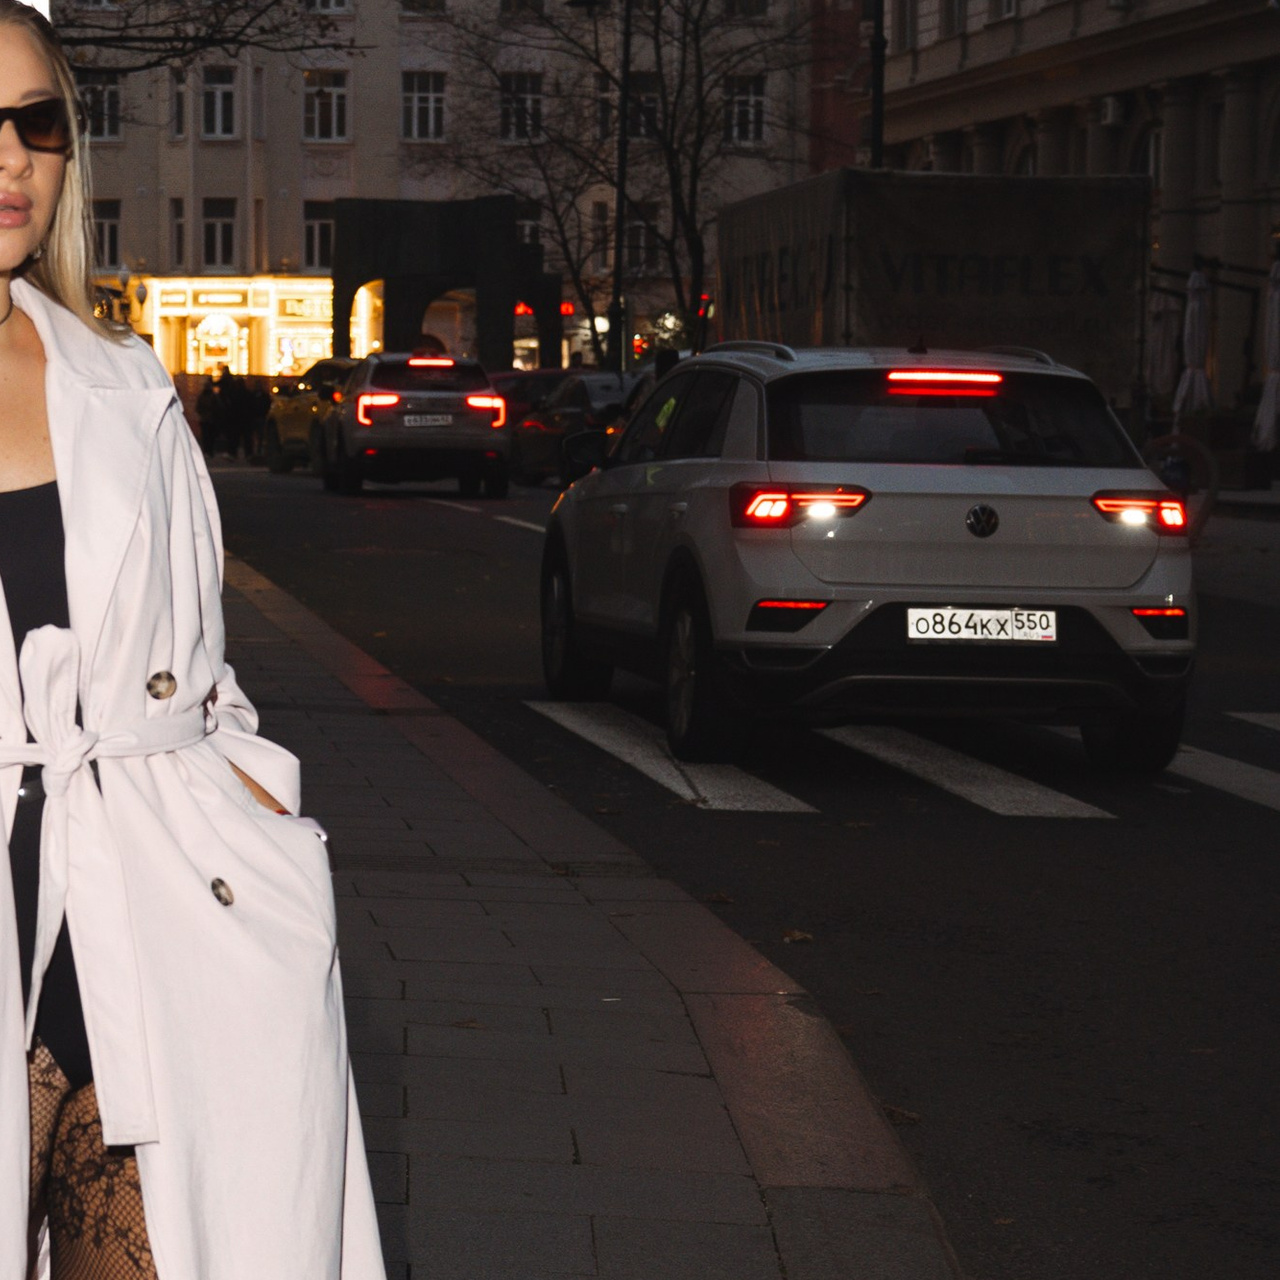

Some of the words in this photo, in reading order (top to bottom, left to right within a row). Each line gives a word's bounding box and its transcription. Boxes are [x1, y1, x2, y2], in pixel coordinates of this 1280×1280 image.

[880, 246, 1109, 297] VITAFLEX
[1014, 612, 1050, 631] 550
[1023, 631, 1041, 639] RUS
